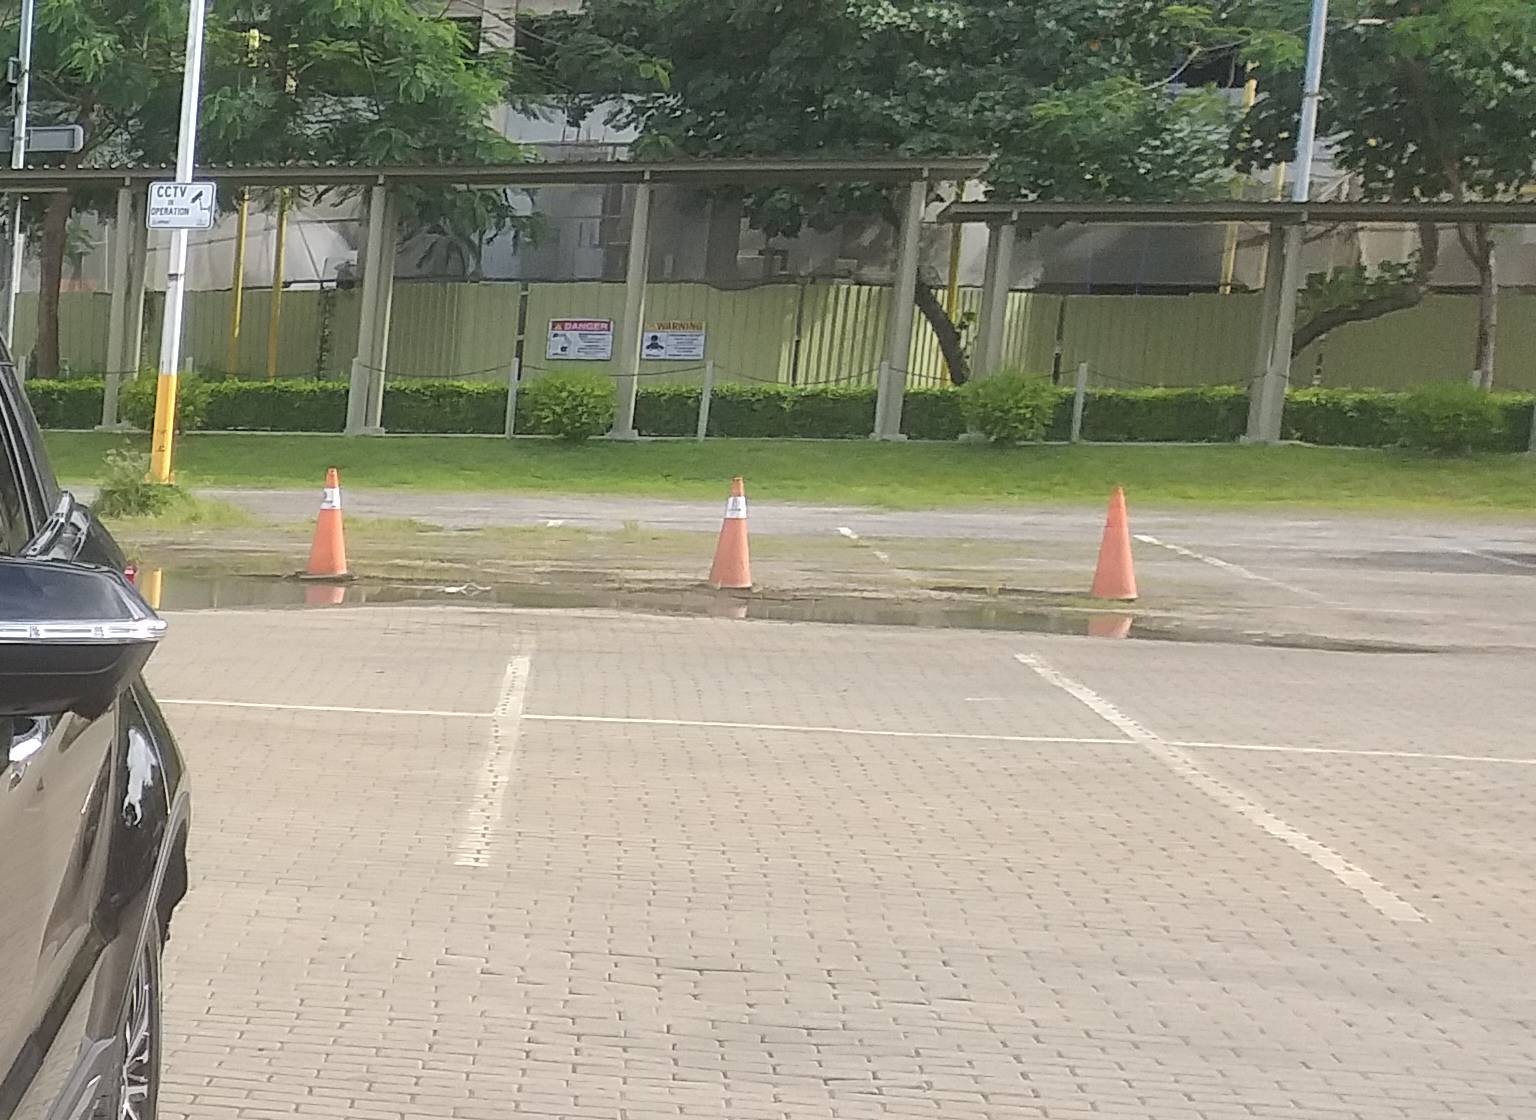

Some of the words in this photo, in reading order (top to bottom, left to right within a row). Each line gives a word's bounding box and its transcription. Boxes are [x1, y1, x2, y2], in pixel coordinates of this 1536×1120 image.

[156, 185, 188, 198] CCTV
[150, 207, 190, 216] OPERATION
[563, 321, 610, 331] DANGER
[656, 321, 704, 330] WARNING
